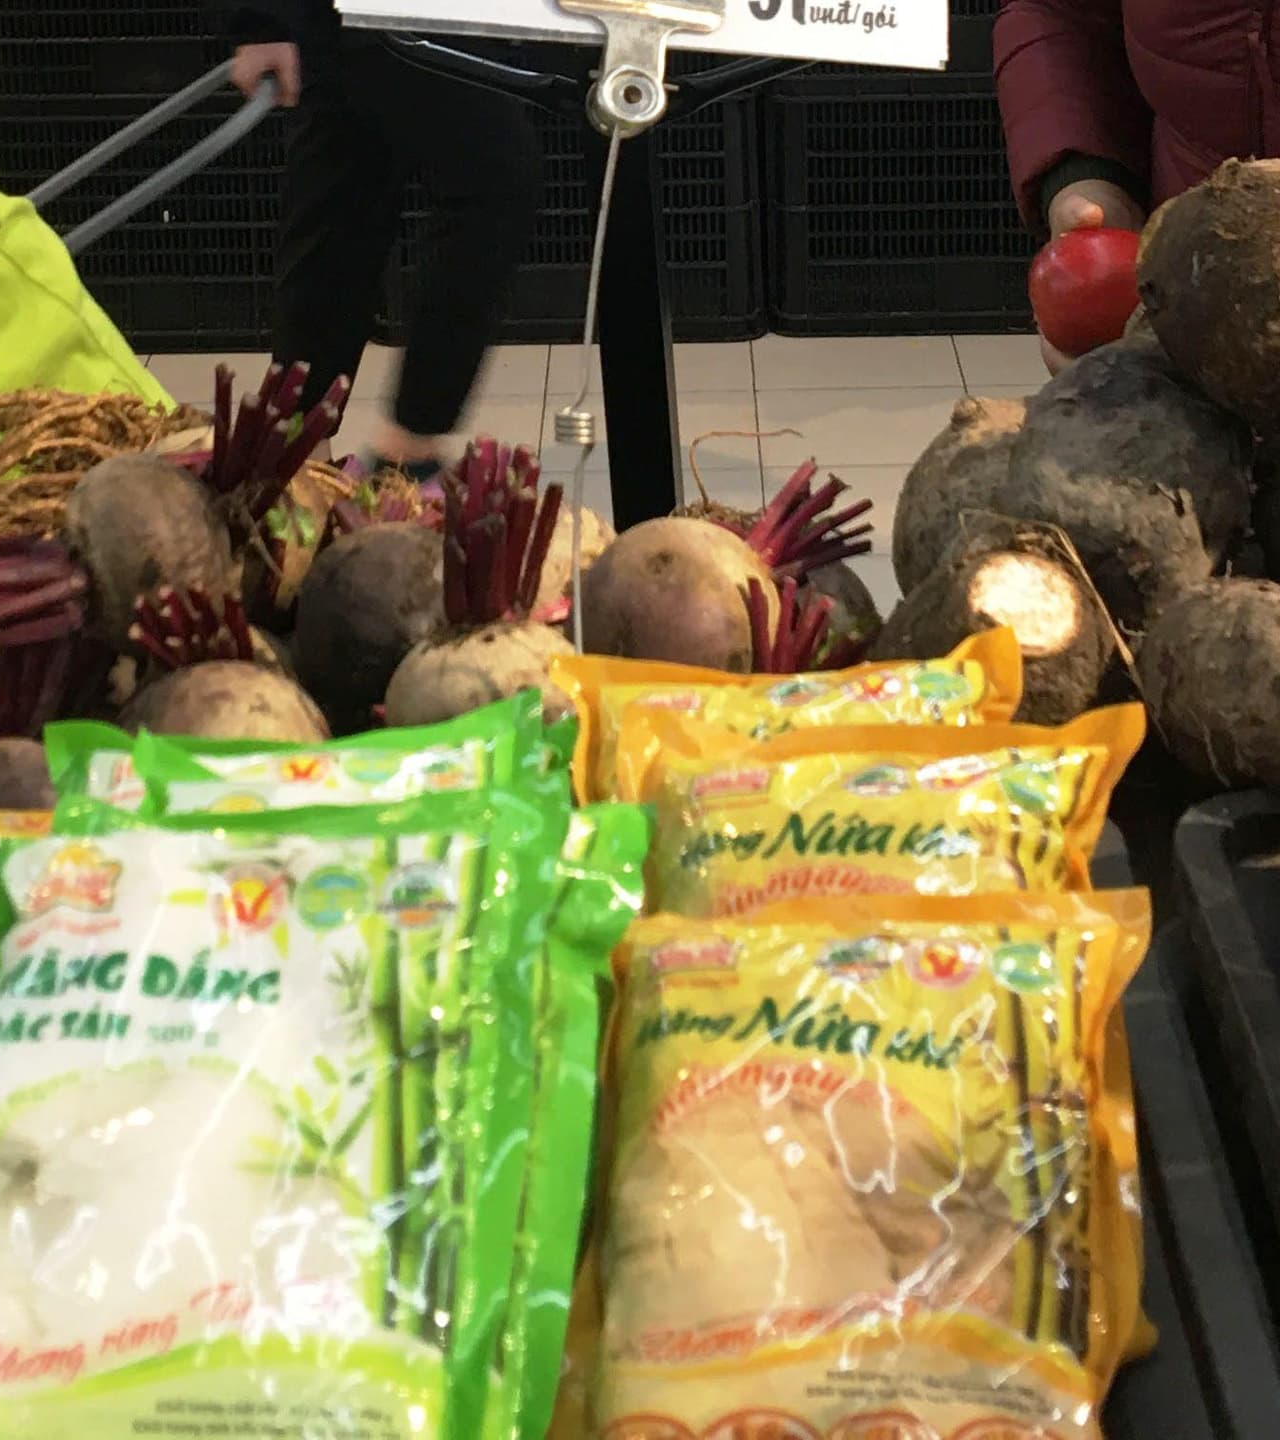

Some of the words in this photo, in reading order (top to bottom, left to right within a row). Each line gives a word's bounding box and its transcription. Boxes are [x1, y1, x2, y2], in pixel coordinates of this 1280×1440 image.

[808, 0, 900, 37] vnđ/gói
[763, 812, 894, 859] Nứa
[734, 996, 881, 1054] Nứa
